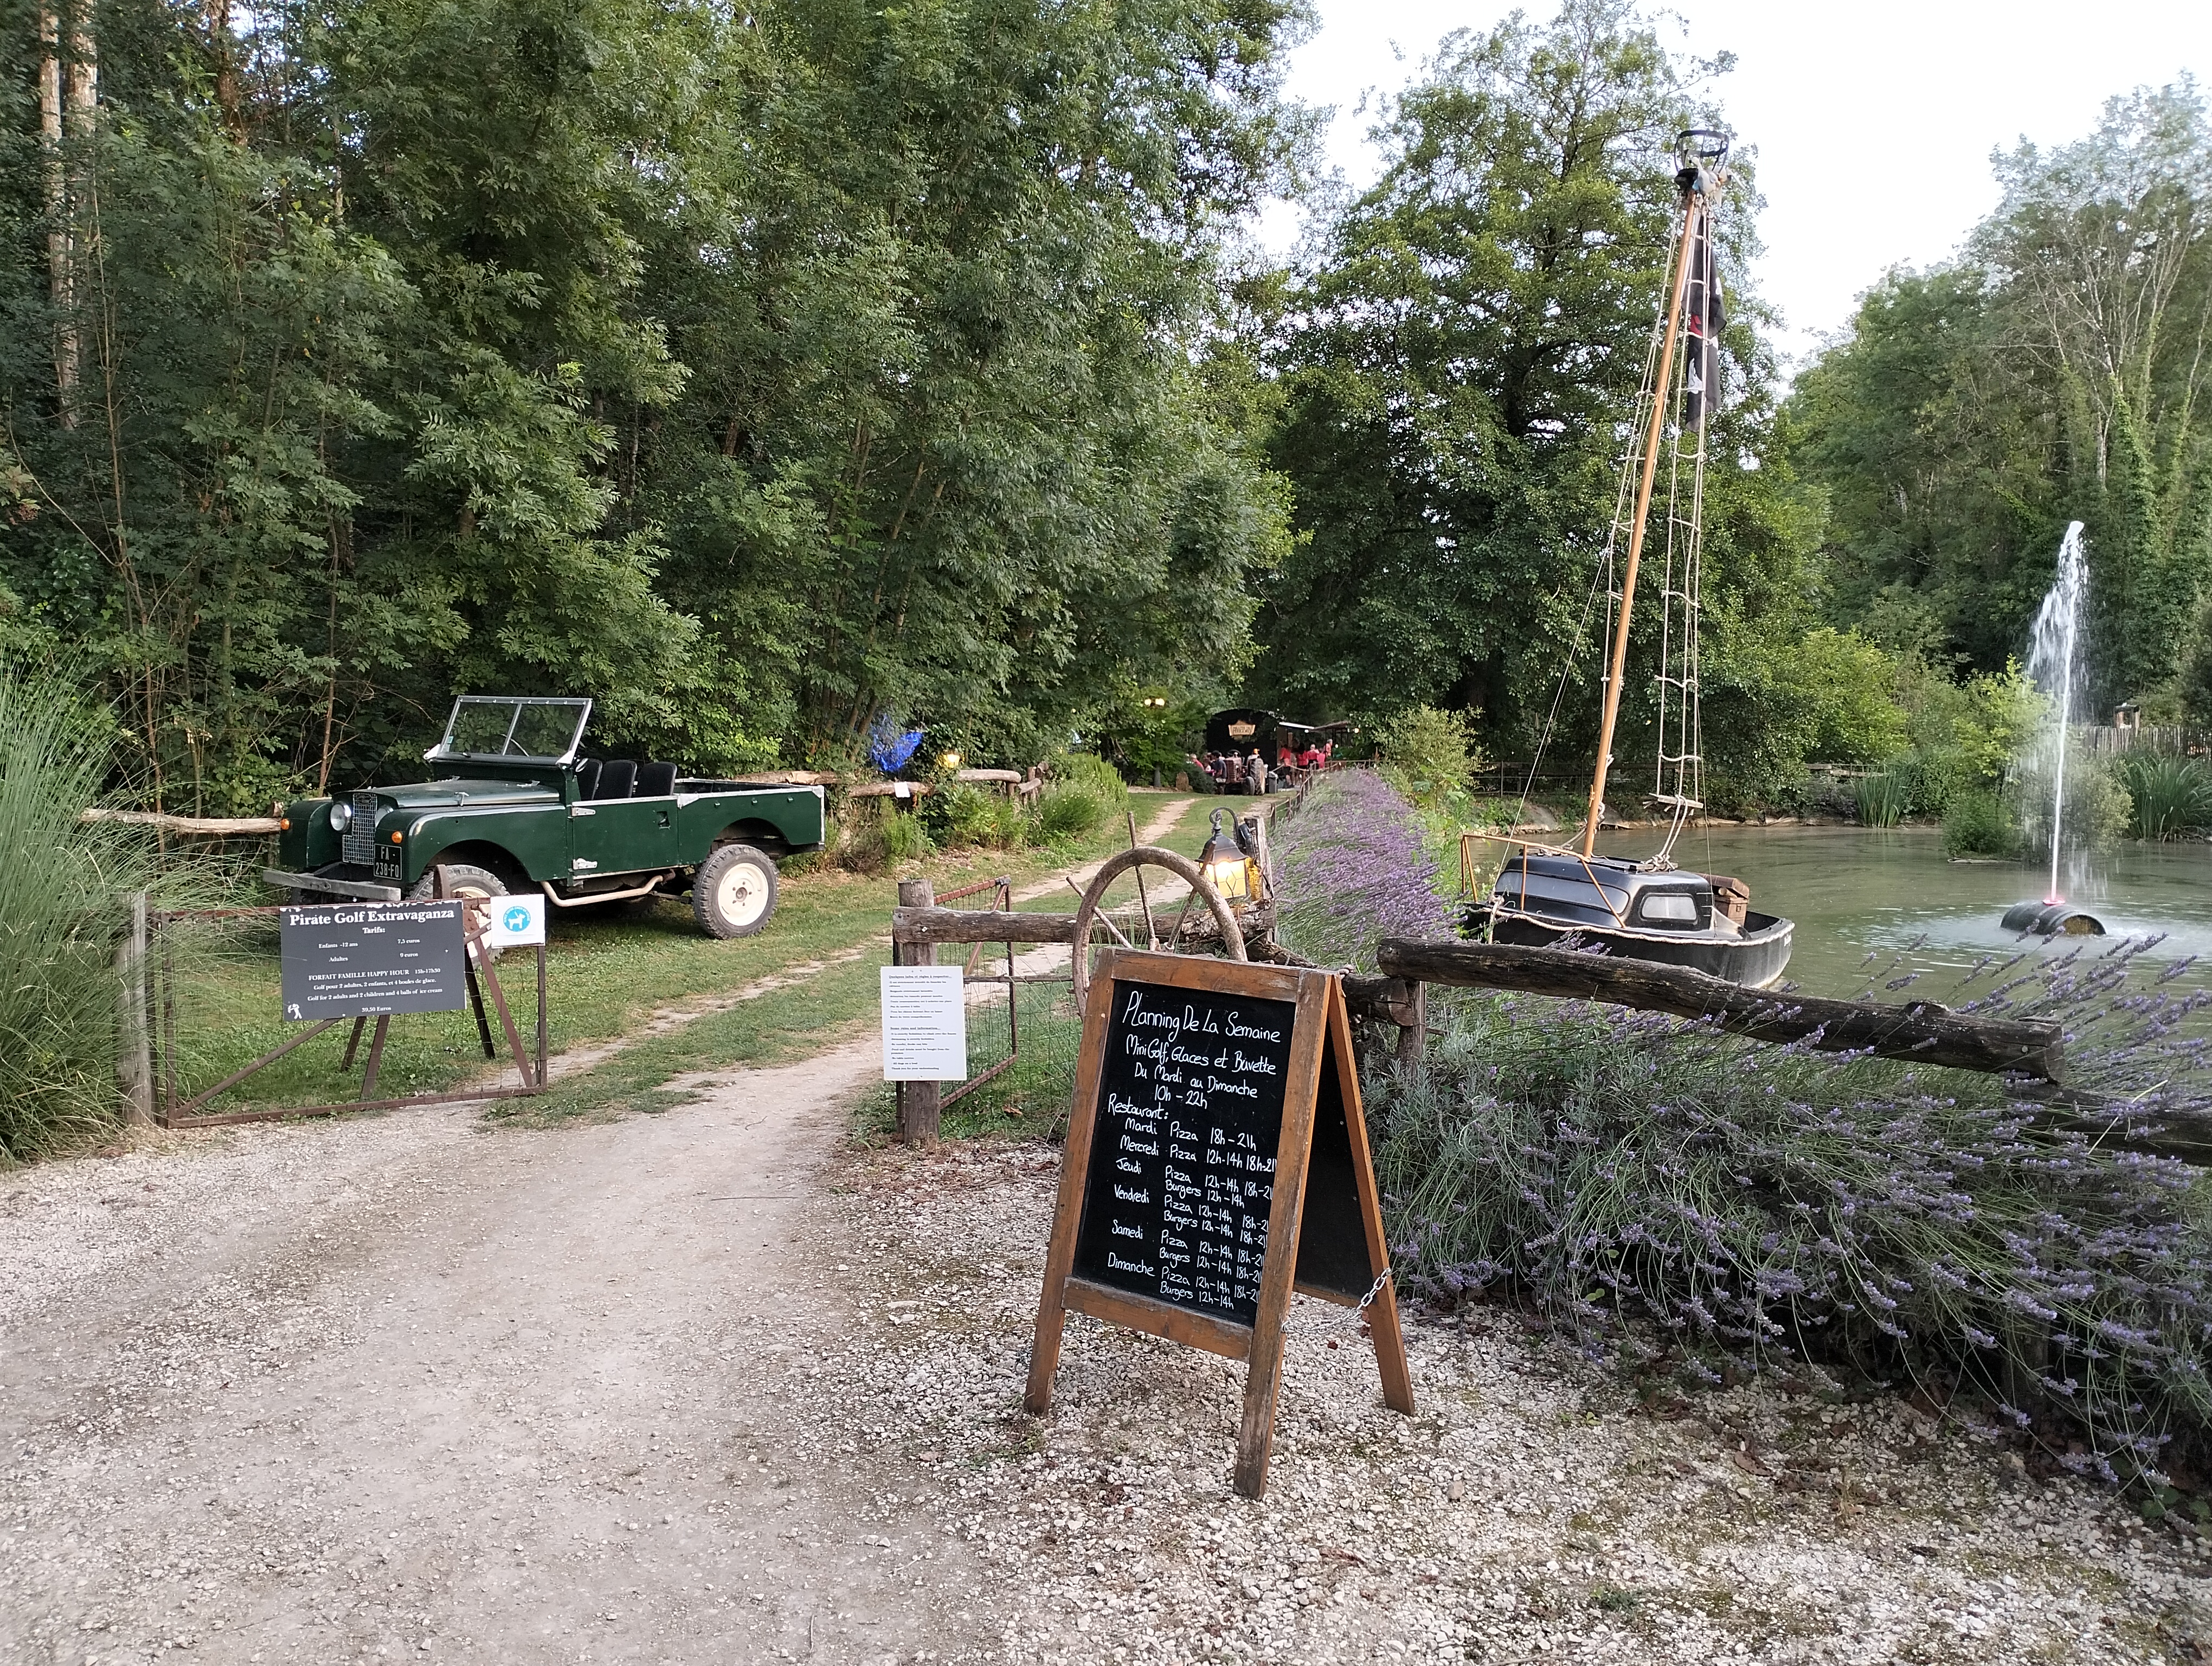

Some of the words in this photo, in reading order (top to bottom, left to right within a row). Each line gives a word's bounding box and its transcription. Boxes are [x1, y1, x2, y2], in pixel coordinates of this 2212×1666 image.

[290, 914, 331, 926] Pirate
[334, 912, 365, 924] Golf
[368, 909, 455, 922] Extravaganza
[1122, 991, 1180, 1042] Planning
[1182, 1005, 1199, 1031] De
[1202, 1009, 1219, 1034] La
[1225, 1011, 1281, 1042] Semaine
[1172, 1046, 1209, 1066] Glaces
[1214, 1048, 1229, 1068] et
[1231, 1050, 1276, 1075] Buvette
[1134, 1062, 1147, 1079] Du
[1154, 1064, 1182, 1084] Mardi
[1190, 1078, 1204, 1089] au
[1207, 1075, 1258, 1098] Dimanche
[1108, 1093, 1169, 1120] Restaurant:
[1154, 1084, 1171, 1101] 10h
[1185, 1090, 1208, 1110] 22h
[1125, 1117, 1158, 1135] Mardi
[1170, 1120, 1199, 1142] Pizza
[1120, 1135, 1159, 1156] Mercredi
[1170, 1144, 1197, 1162] Pizza
[1206, 1149, 1243, 1168] 12h-14h
[1115, 1157, 1142, 1175] Jeudi
[1165, 1165, 1192, 1183] Pizza
[1205, 1174, 1239, 1193] 12h-14h
[1165, 1179, 1201, 1199] Burgers
[1114, 1184, 1149, 1203] Vendredi
[1164, 1194, 1193, 1214] Pizza
[1199, 1204, 1232, 1223] 12h-14h
[1163, 1210, 1198, 1232] Burgers
[1202, 1220, 1233, 1238] 12h-14h
[1111, 1219, 1143, 1240] Samedi
[1161, 1229, 1188, 1250] Pizza
[1199, 1240, 1232, 1260] 12h-14h
[1108, 1252, 1155, 1277] Dimanche
[1162, 1266, 1191, 1286] Pizza
[1195, 1276, 1230, 1295] 12h-14h
[1159, 1247, 1191, 1268] Burgers
[1197, 1255, 1232, 1276] 12h-14h
[1160, 1280, 1193, 1301] Burgers
[1199, 1291, 1234, 1310] 12h-14h
